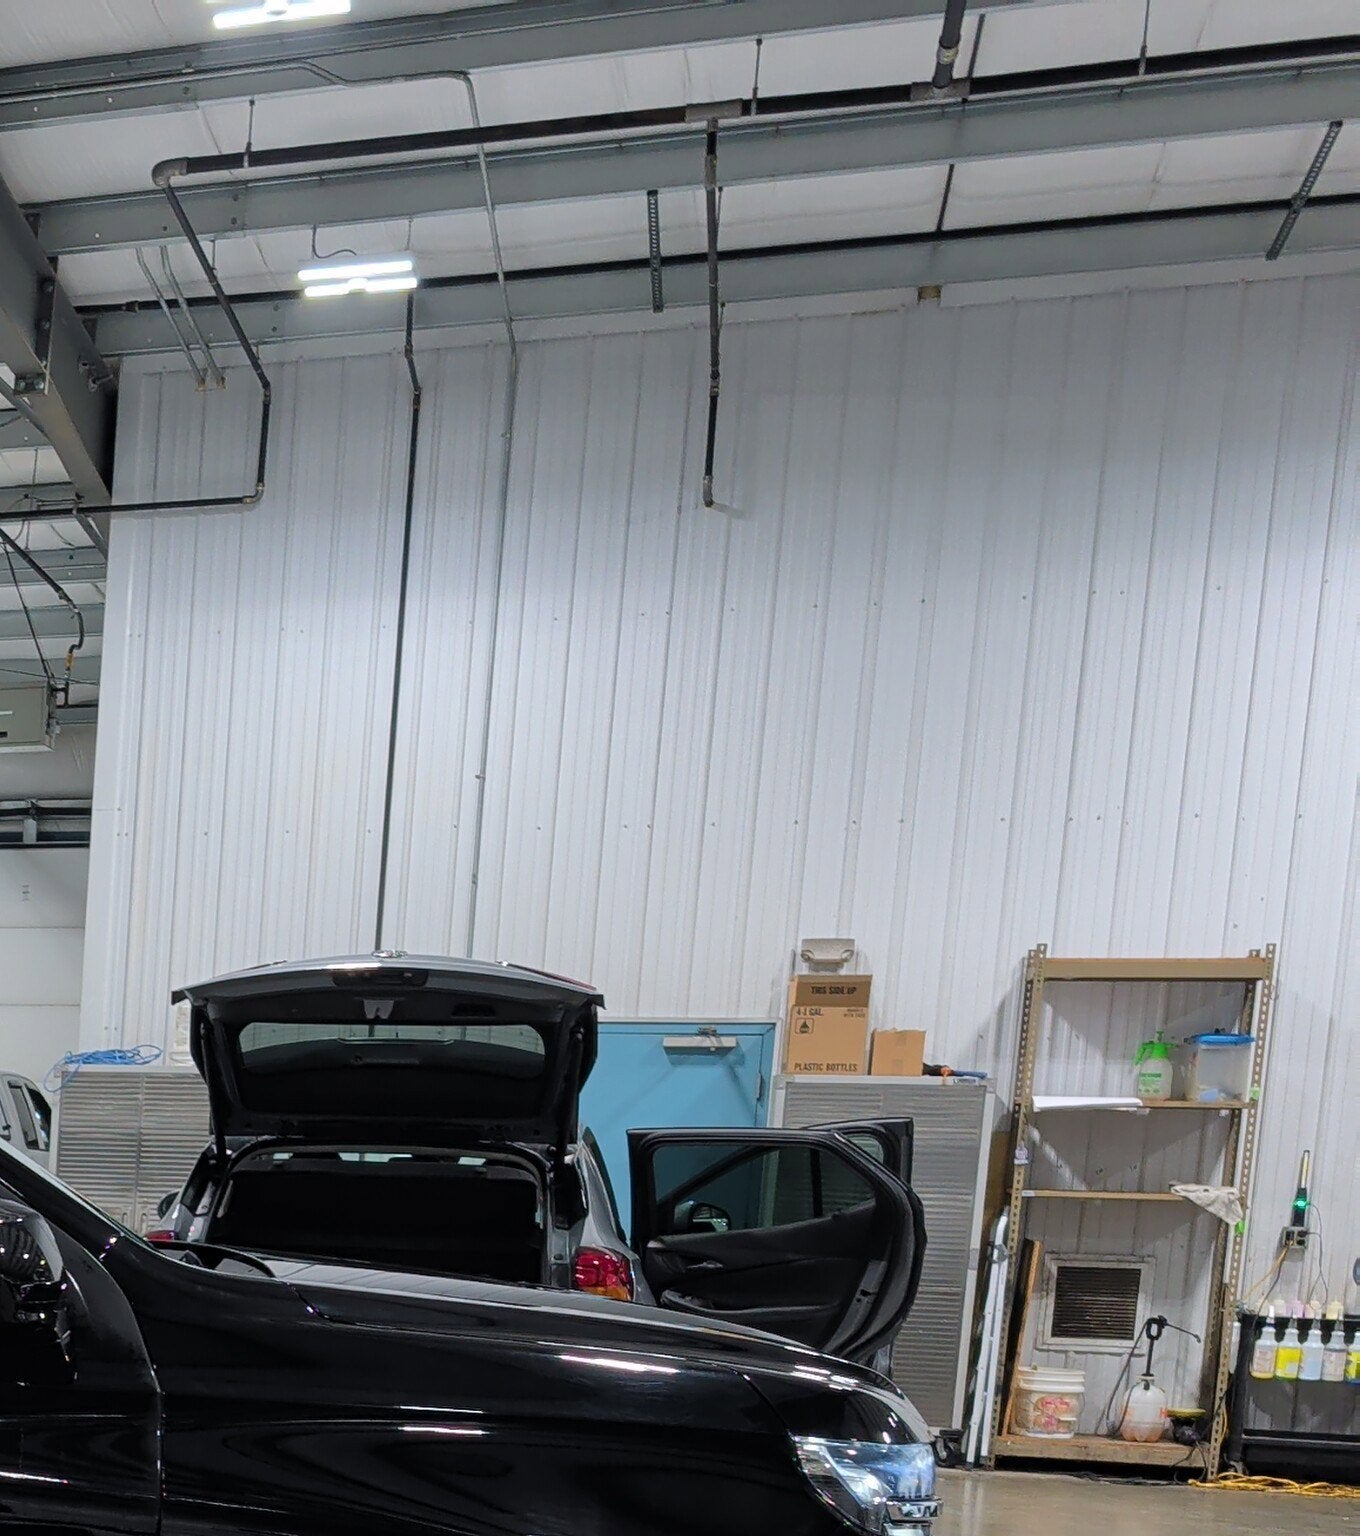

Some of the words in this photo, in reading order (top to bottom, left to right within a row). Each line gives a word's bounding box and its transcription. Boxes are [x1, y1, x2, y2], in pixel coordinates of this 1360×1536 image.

[829, 986, 845, 995] SIDE
[847, 986, 857, 995] UP
[793, 1063, 824, 1072] PLASTIC
[826, 1063, 858, 1072] BOTTLES
